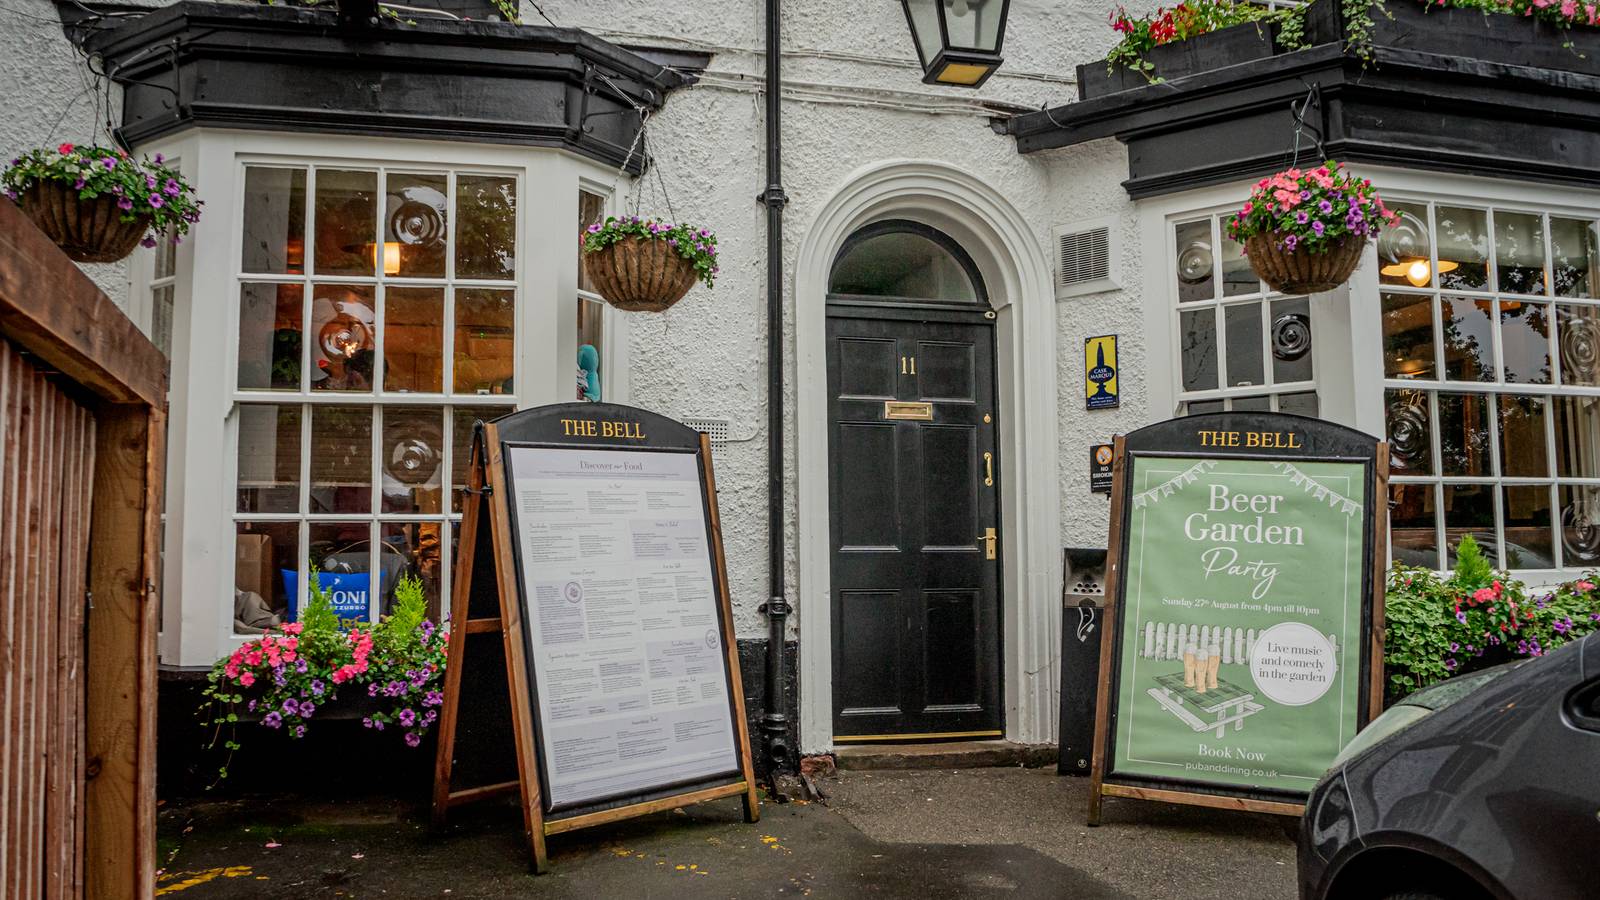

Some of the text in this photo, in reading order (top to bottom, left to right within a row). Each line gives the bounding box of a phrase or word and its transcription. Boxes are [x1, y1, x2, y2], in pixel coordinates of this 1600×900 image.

[902, 357, 915, 374] 11
[561, 419, 646, 439] THE BELL
[1198, 430, 1302, 449] THE BELL
[580, 460, 612, 470] Discover
[623, 462, 643, 471] Food
[1207, 484, 1283, 514] Beer
[1184, 513, 1305, 545] Garden
[1201, 546, 1281, 600] Party
[1162, 597, 1193, 608] Sunday
[1210, 600, 1239, 610] August
[1240, 601, 1262, 611] from
[1263, 603, 1282, 614] 4pm
[1283, 603, 1295, 613] till
[1296, 605, 1320, 616] 10pm
[1268, 642, 1323, 656] Live music
[1261, 655, 1325, 672] and comedy
[1259, 668, 1326, 682] in the garden
[1198, 744, 1267, 761] Book Now
[1185, 762, 1278, 778] pubanddining.co.uk
